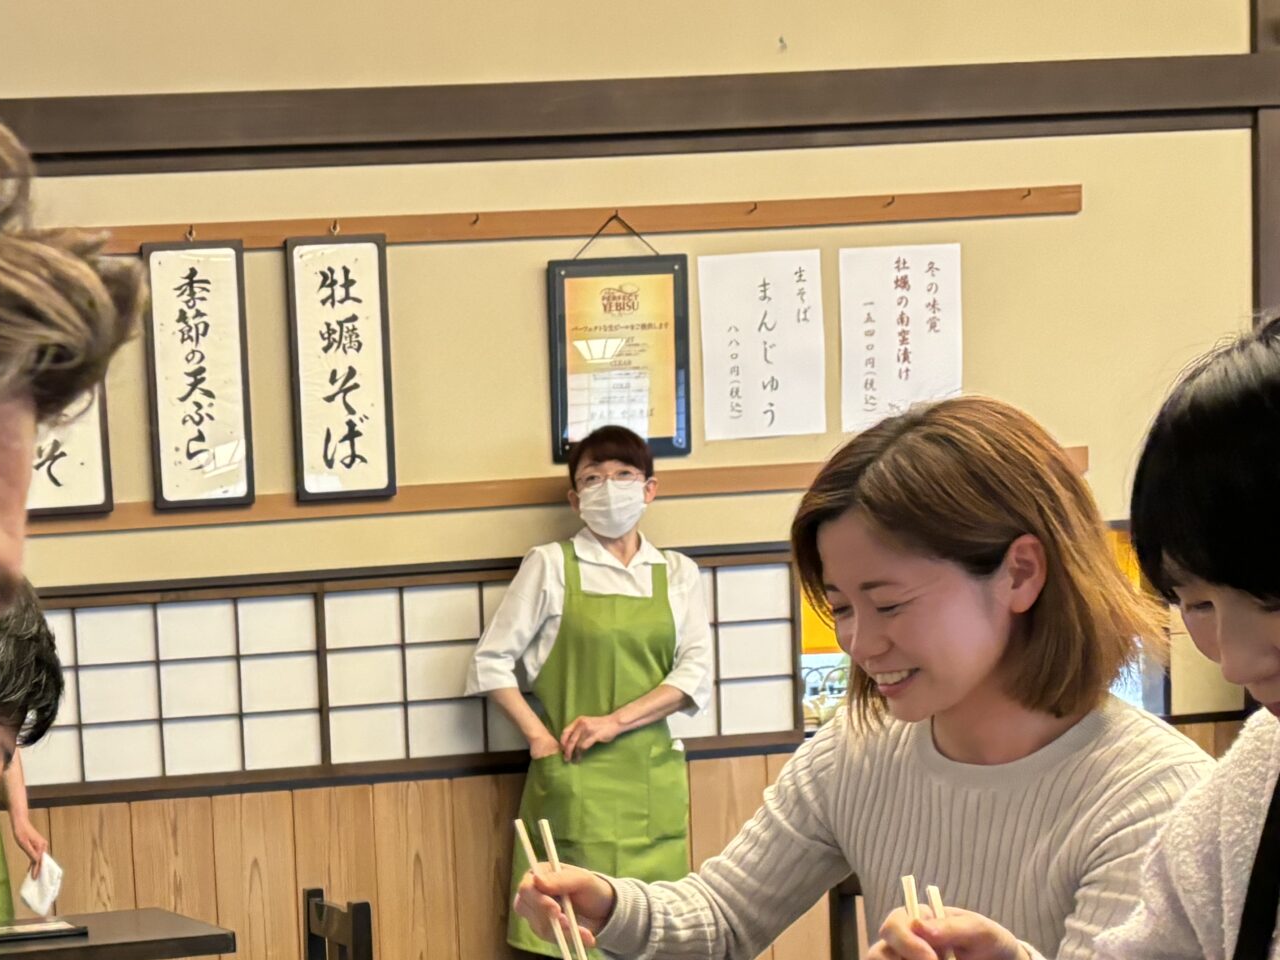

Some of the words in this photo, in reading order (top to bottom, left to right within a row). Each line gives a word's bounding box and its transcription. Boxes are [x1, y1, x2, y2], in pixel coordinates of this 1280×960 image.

[601, 301, 639, 314] YEBISU
[794, 266, 811, 323] 生そば
[924, 261, 941, 333] 冬の味覚
[172, 267, 217, 471] 季節の天ぷら
[317, 265, 370, 469] 牡蠣そば
[757, 277, 780, 428] まんじゅう
